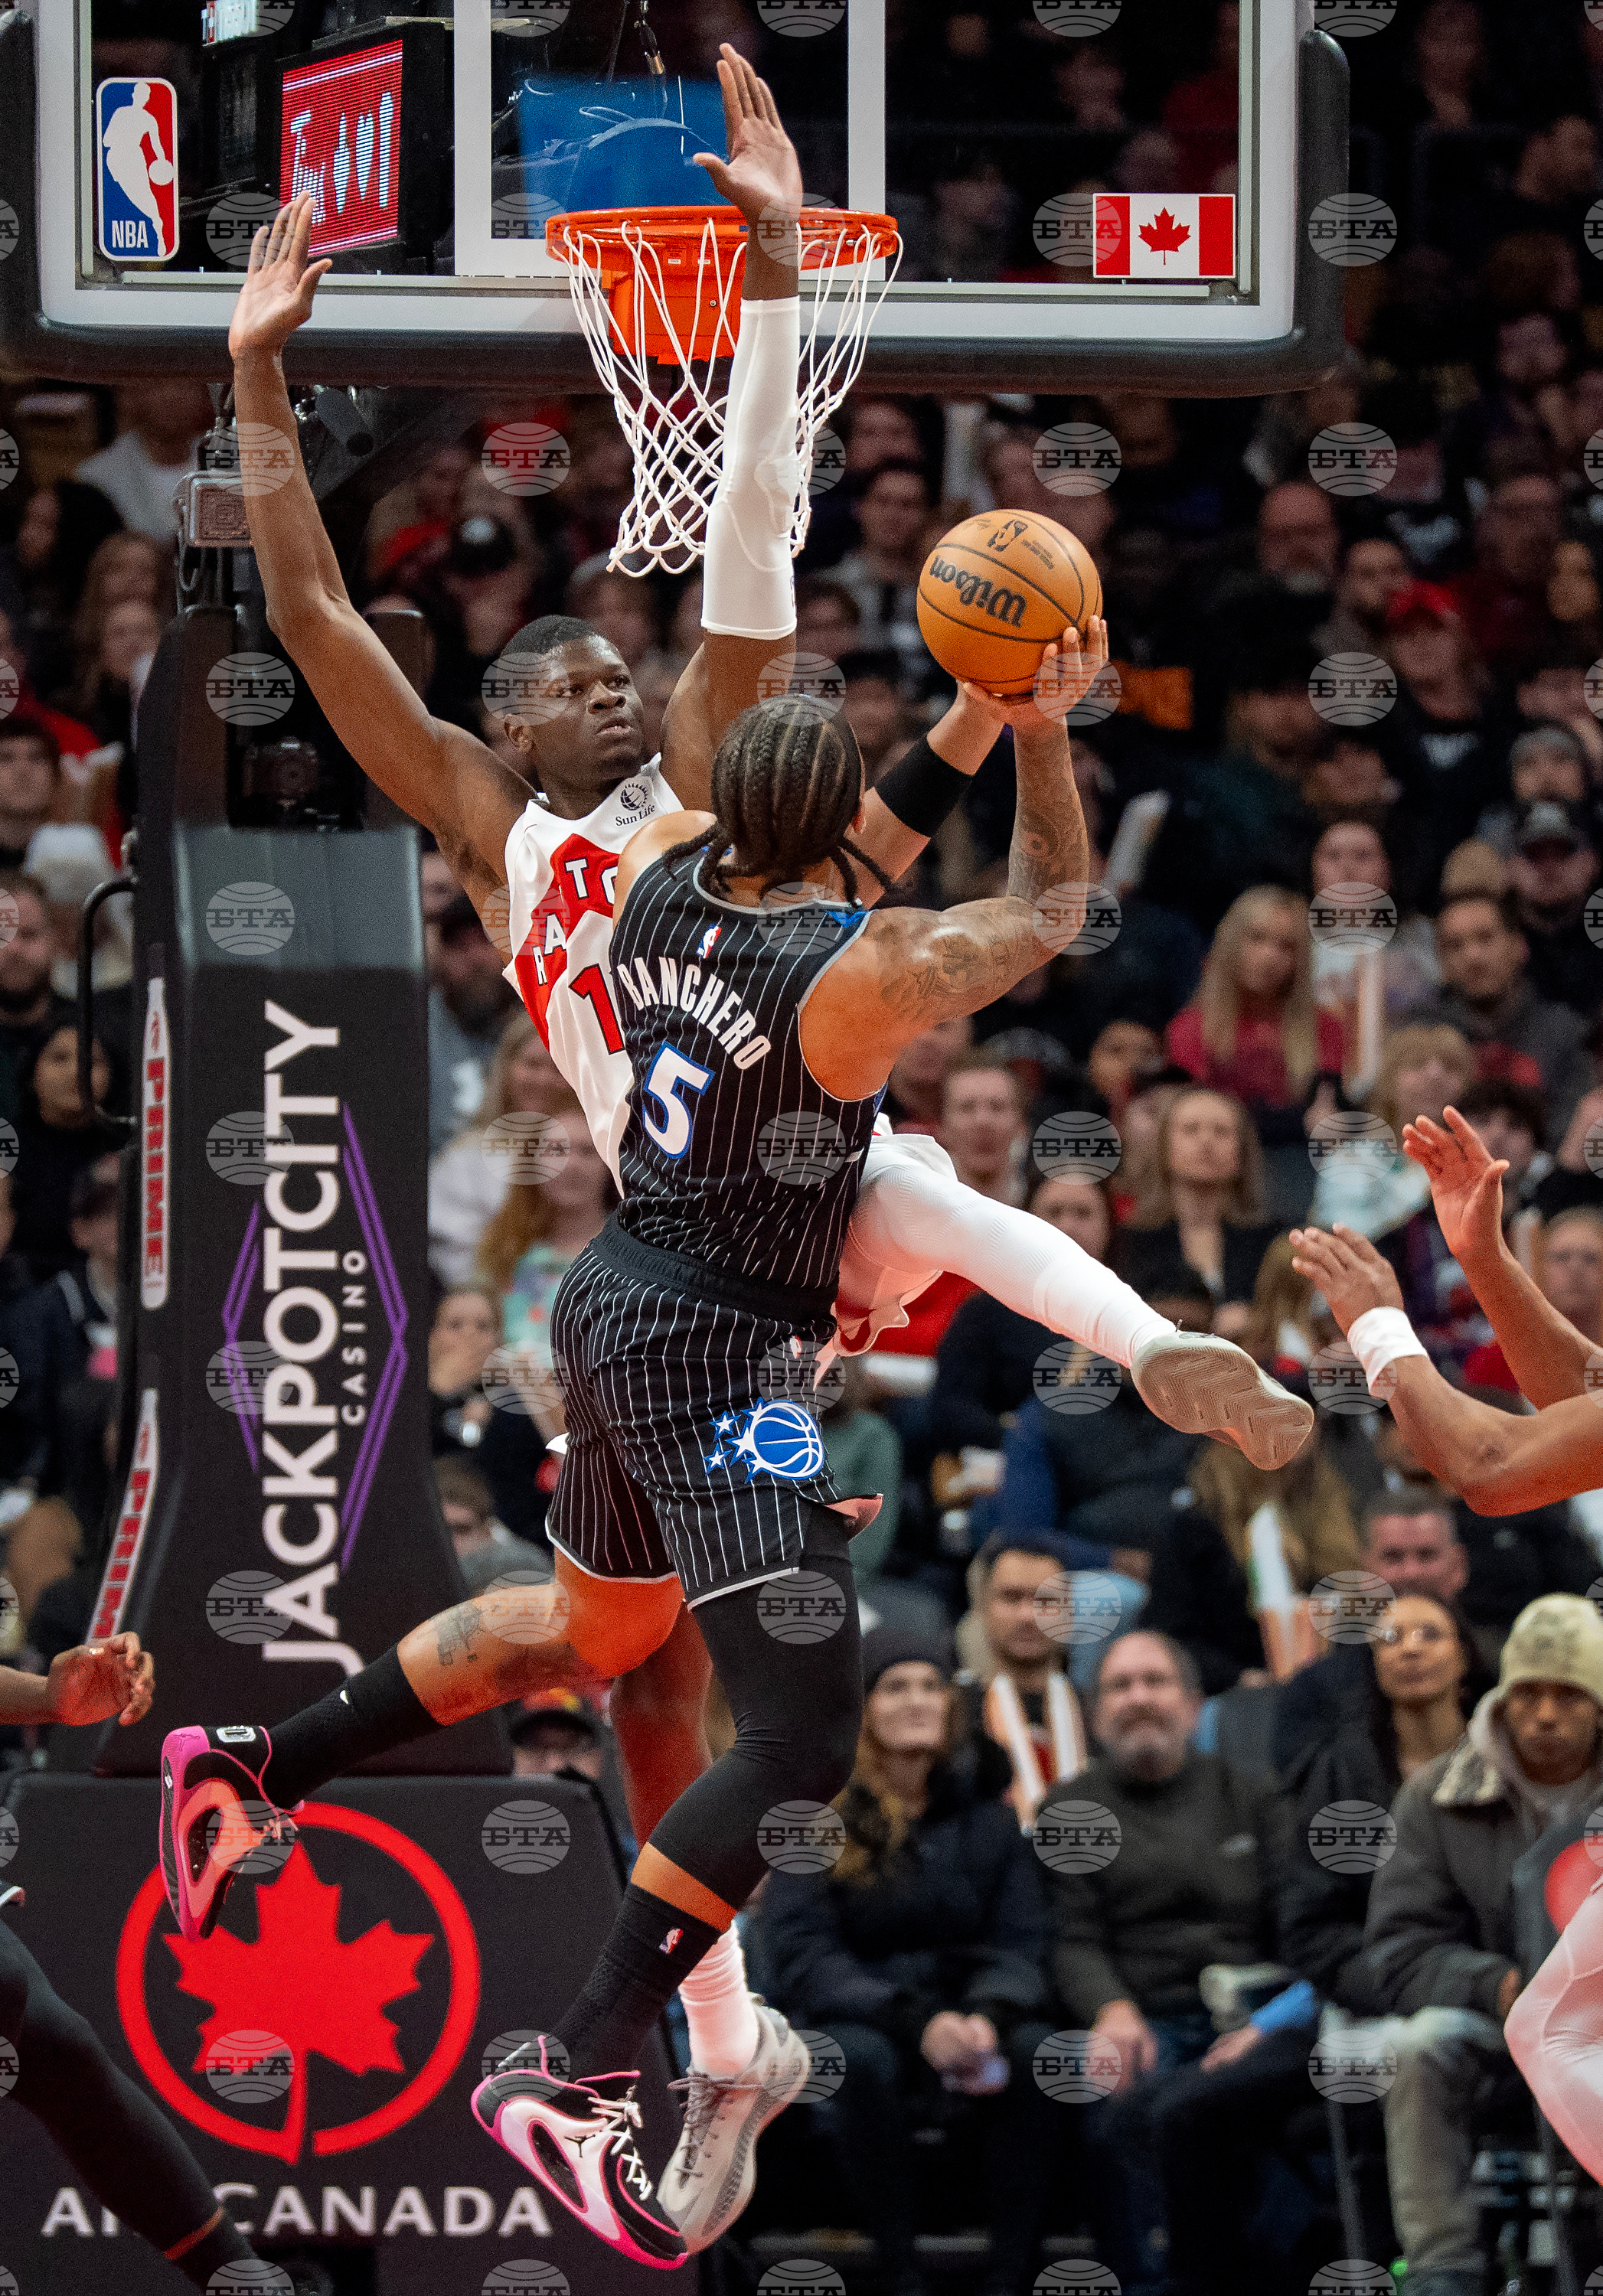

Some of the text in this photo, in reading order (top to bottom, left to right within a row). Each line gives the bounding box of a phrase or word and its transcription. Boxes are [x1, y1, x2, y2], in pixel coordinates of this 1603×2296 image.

[112, 220, 149, 249] NBA
[929, 554, 1027, 628] Wilson
[615, 804, 655, 827] Sun Life
[617, 957, 772, 1070] BANCHERO
[642, 1039, 715, 1159] 5
[145, 1058, 165, 1276] PRIME
[263, 998, 364, 1678] JACKPOTCITY
[341, 1250, 367, 1426] CASINO
[93, 1468, 152, 1639] PRIM
